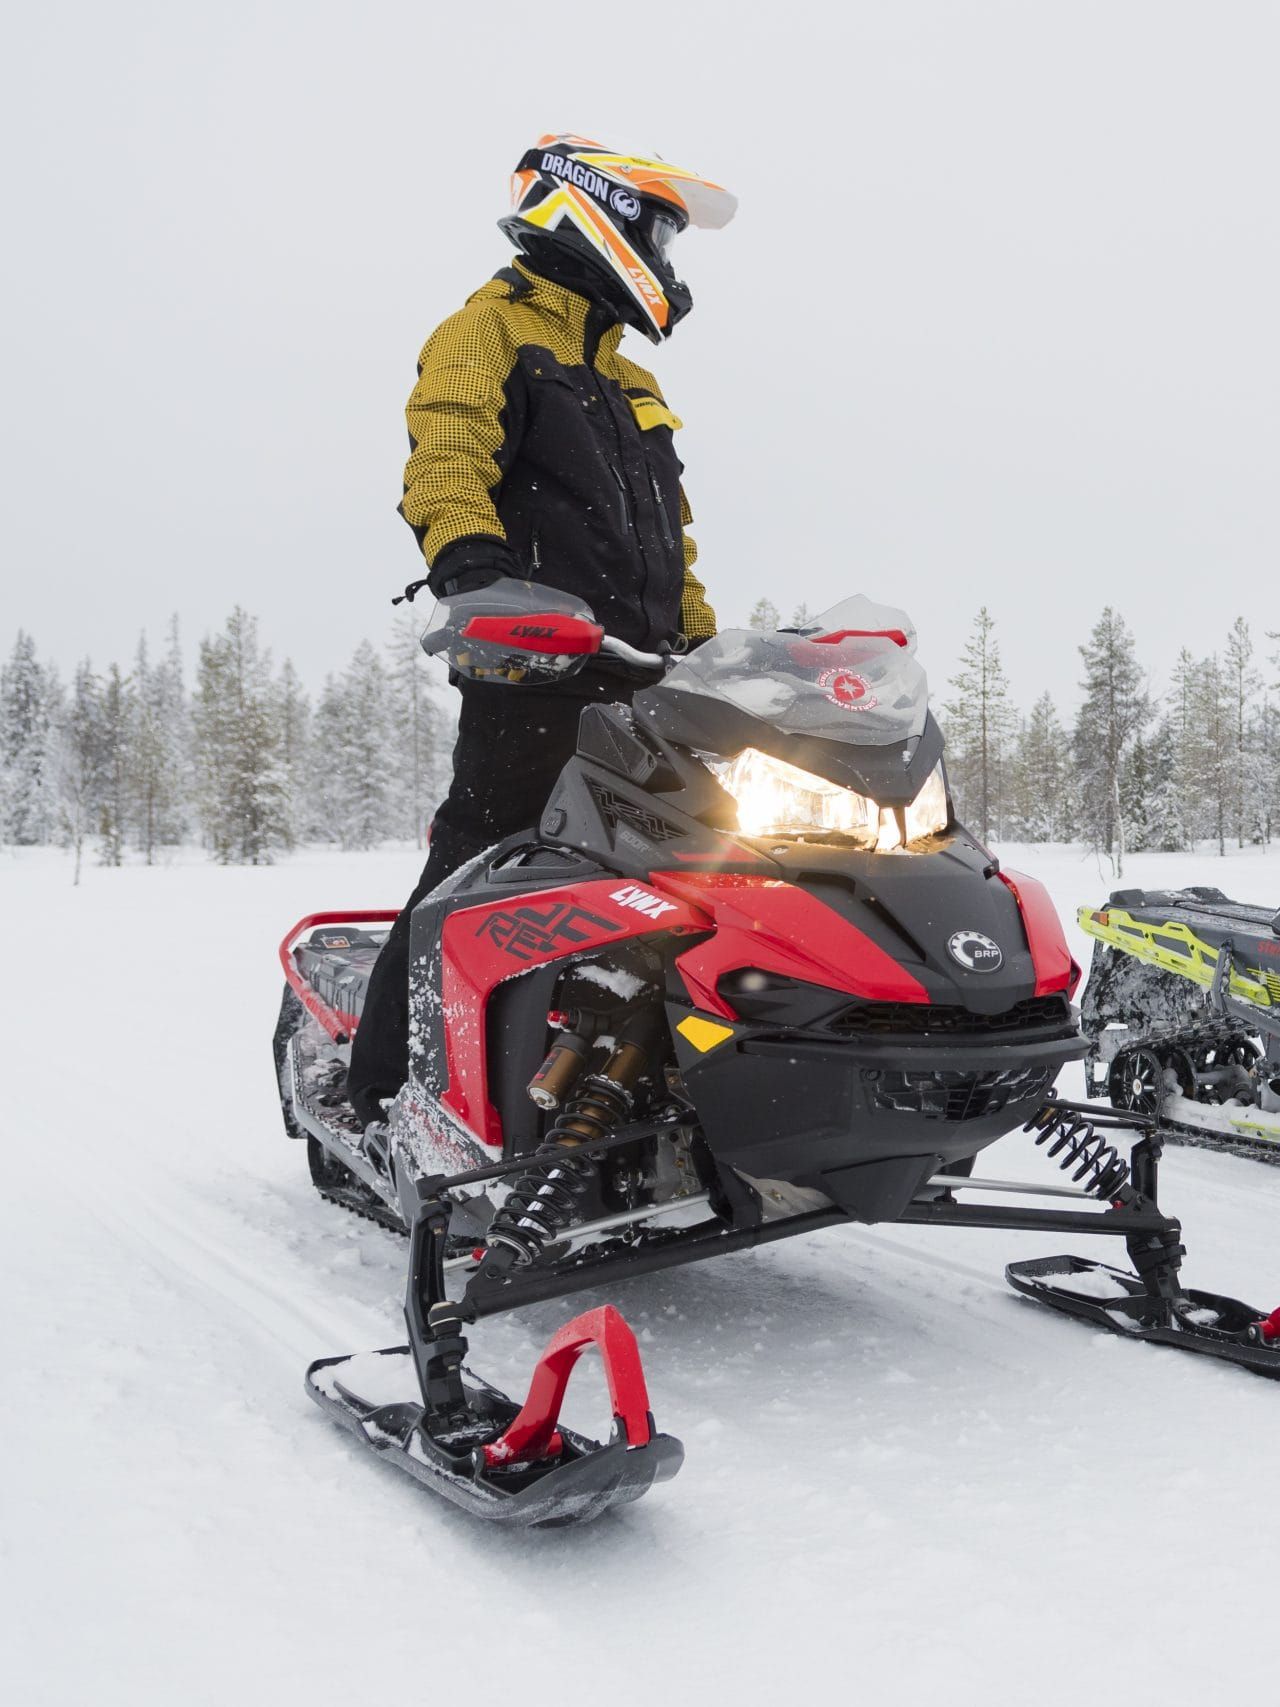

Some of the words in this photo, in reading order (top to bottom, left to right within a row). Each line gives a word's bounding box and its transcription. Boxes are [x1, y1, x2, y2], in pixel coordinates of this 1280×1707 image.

[541, 152, 610, 203] DRAGON
[627, 266, 664, 306] LYNX
[509, 624, 560, 639] LYNX
[608, 885, 679, 920] LYNX
[974, 949, 999, 959] BRP
